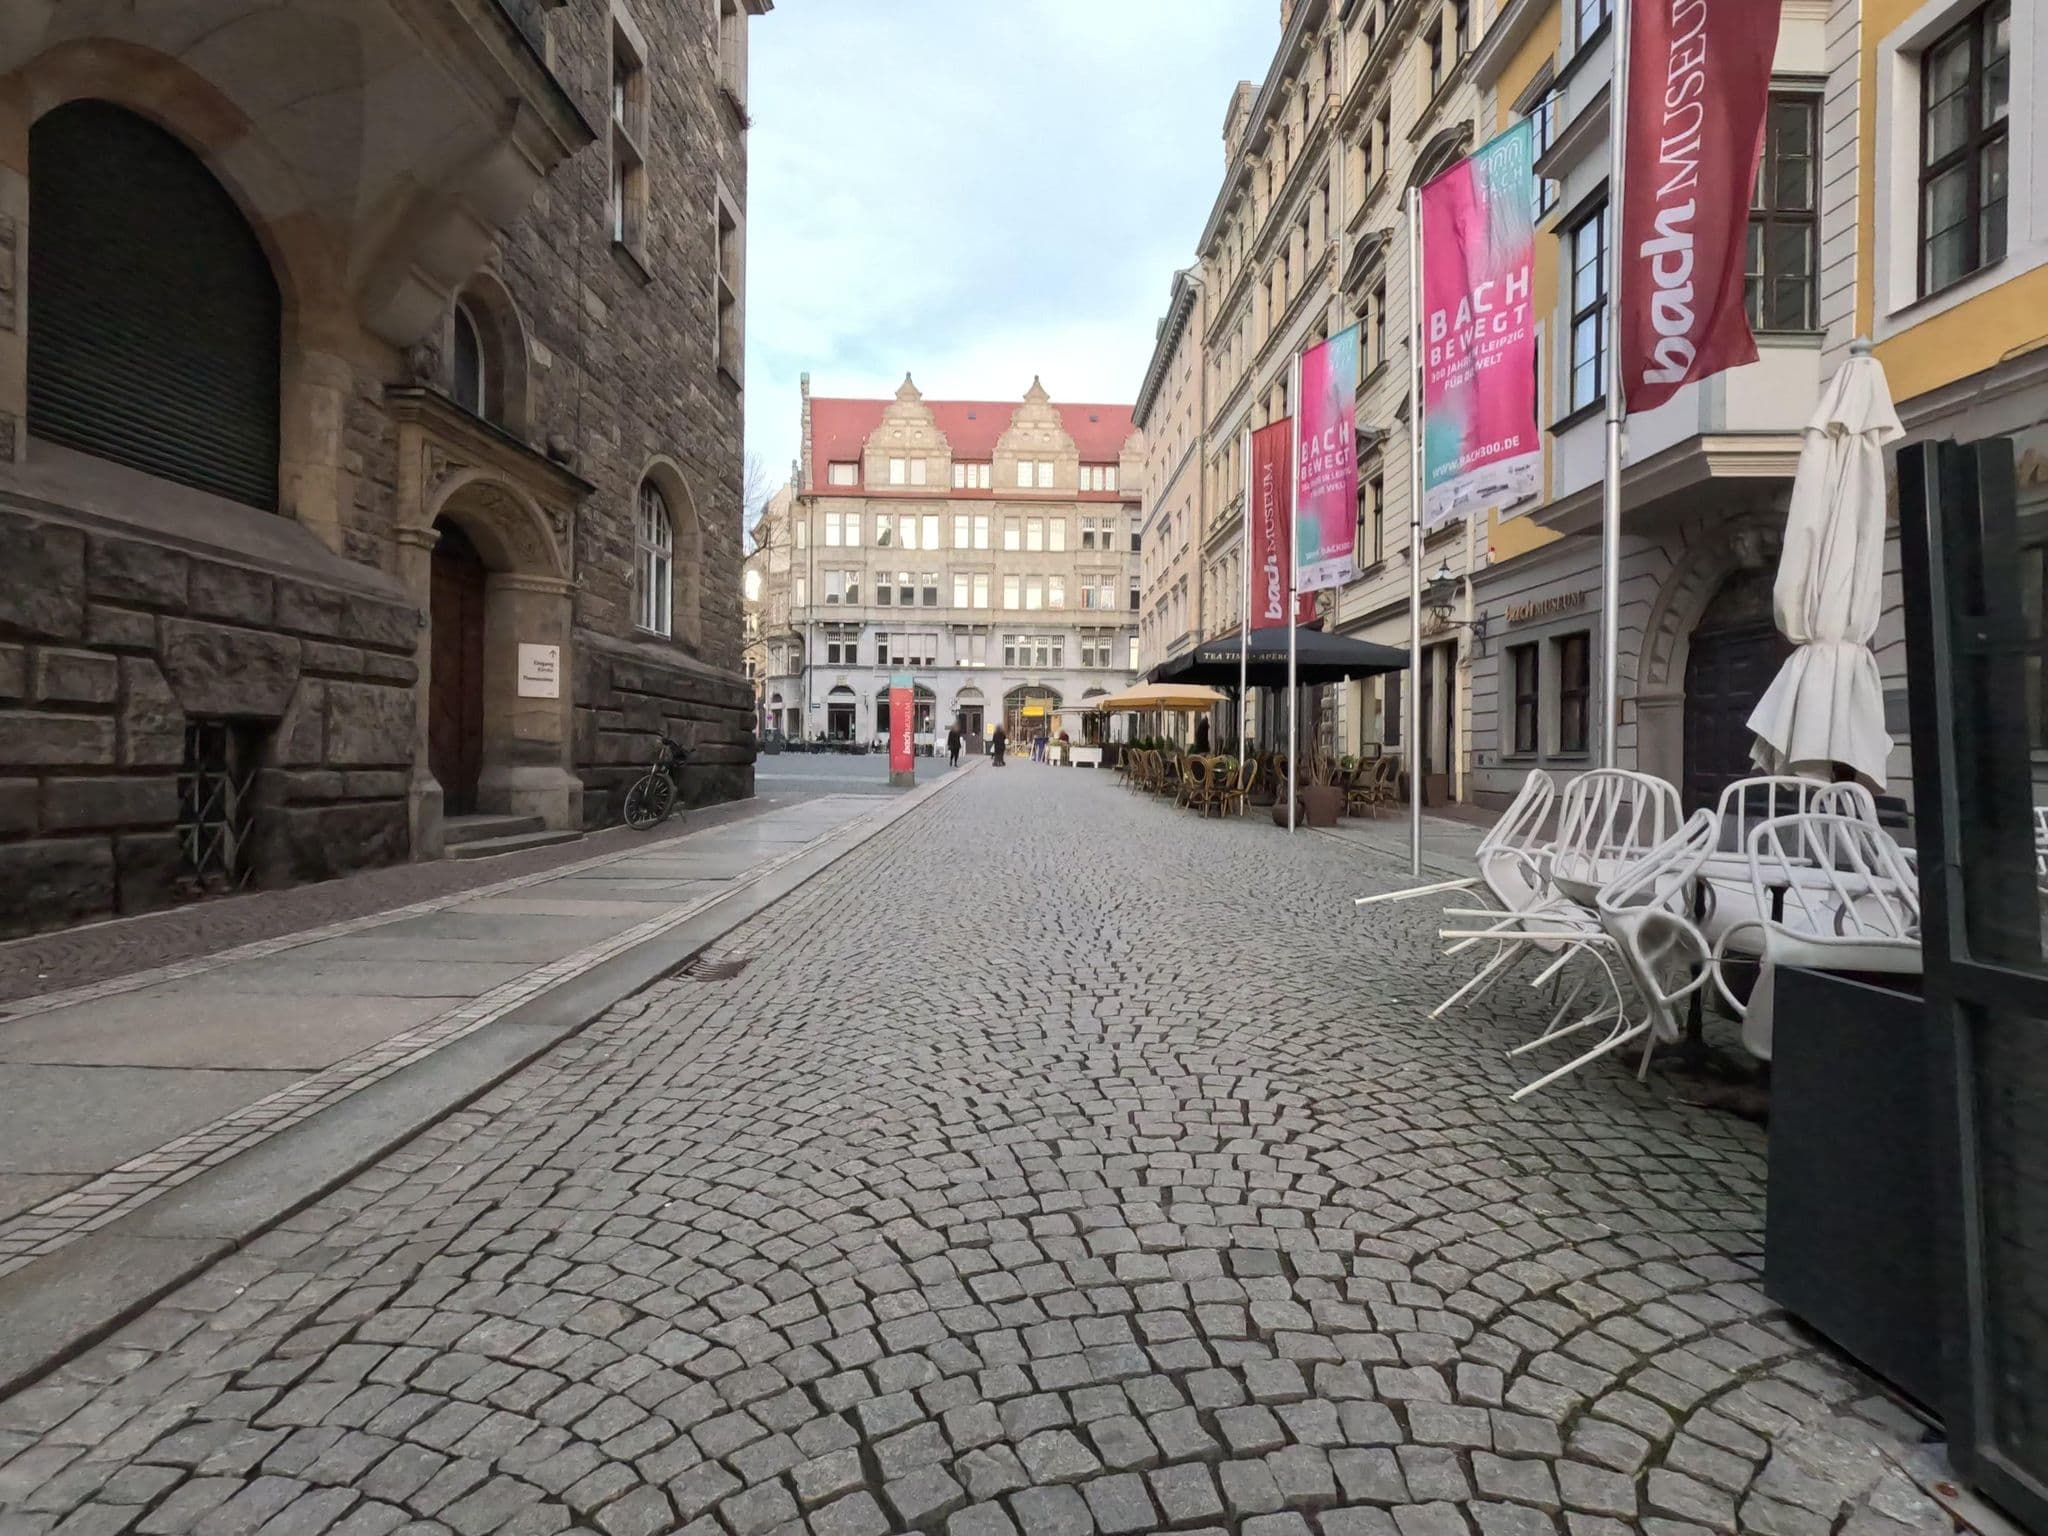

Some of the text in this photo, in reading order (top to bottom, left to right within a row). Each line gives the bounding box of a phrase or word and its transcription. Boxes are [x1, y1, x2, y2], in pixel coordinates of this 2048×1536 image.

[1430, 265, 1529, 343] BACH
[1430, 302, 1528, 368] BEWEGT
[1481, 328, 1525, 354] LEIPZIG
[1301, 421, 1350, 464] BACH
[1300, 447, 1351, 481] BEWEGT
[1203, 652, 1223, 661] TEA
